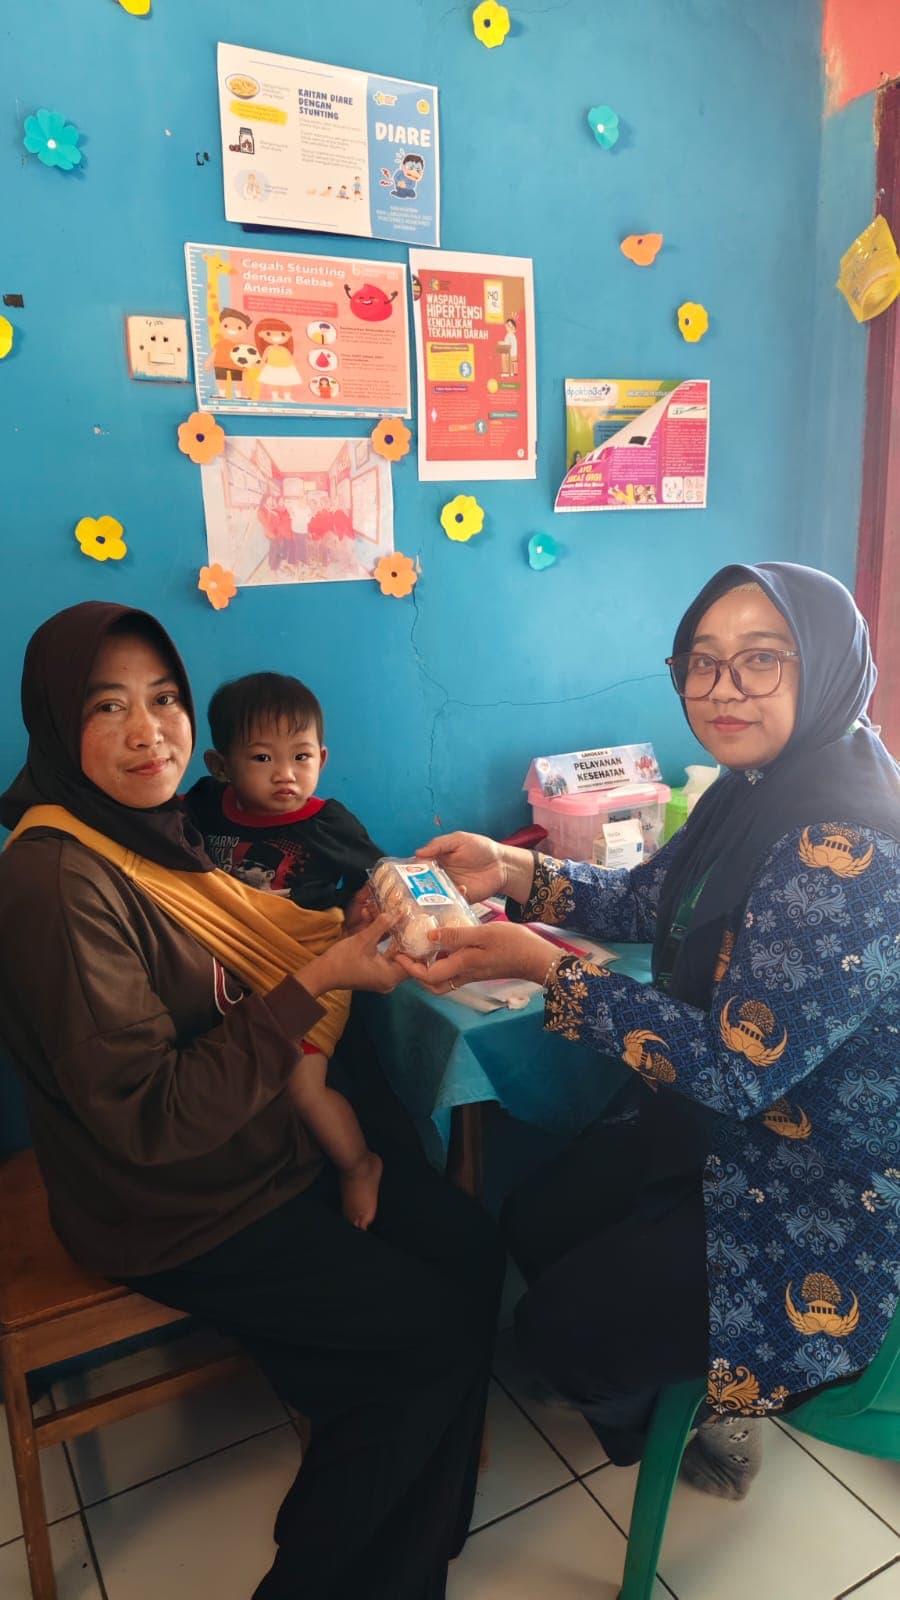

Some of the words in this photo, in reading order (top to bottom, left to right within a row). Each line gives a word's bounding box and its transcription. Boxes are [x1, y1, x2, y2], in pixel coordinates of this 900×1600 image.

[298, 88, 327, 101] KAITAN
[330, 94, 353, 106] DIARE
[298, 97, 332, 110] DENGAN
[299, 106, 339, 120] STUNTING
[375, 121, 431, 147] DIARE
[242, 259, 283, 271] Cegah
[287, 263, 345, 279] Stunting
[243, 271, 292, 284] dengan
[295, 275, 334, 288] Bebas
[243, 282, 293, 295] Anemia
[426, 293, 466, 306] WASPADAI
[427, 304, 483, 320] HIPERTENSI
[427, 317, 473, 329] KENDALIKAN
[428, 327, 462, 339] TEKANAN
[463, 328, 489, 340] DARAH
[574, 757, 623, 770] PELAYANAN
[577, 768, 625, 782] KESEHATAN
